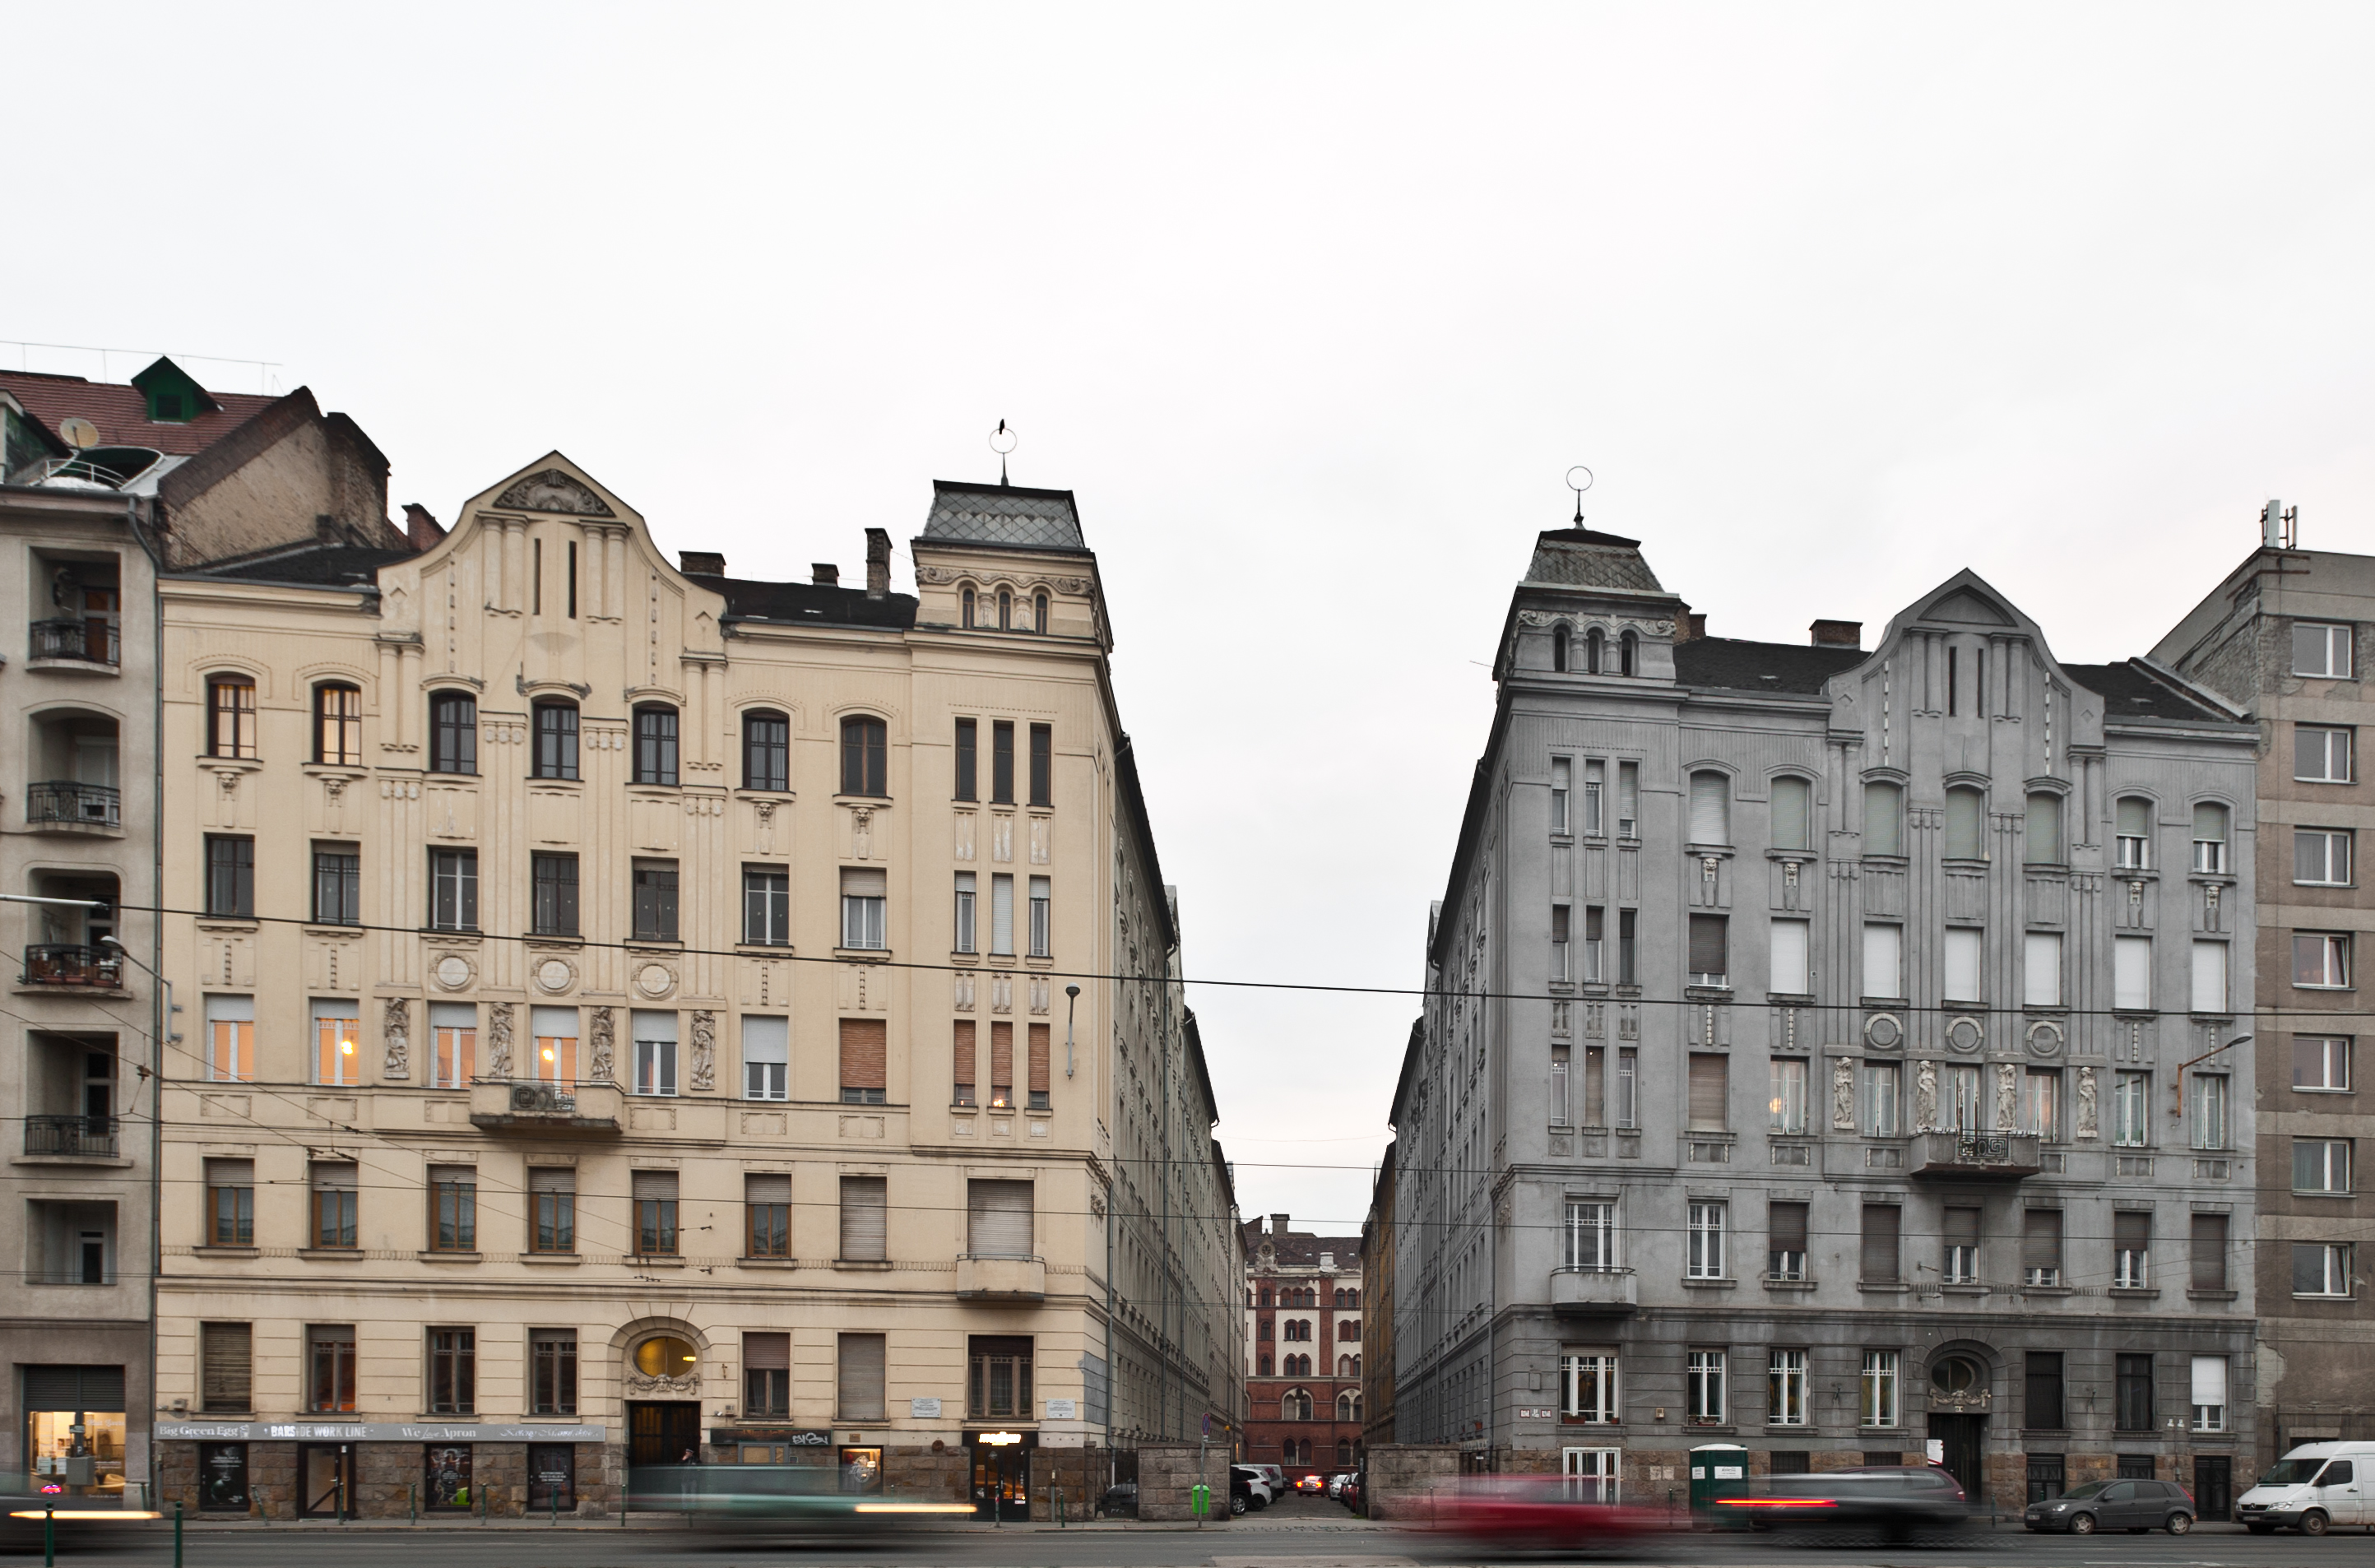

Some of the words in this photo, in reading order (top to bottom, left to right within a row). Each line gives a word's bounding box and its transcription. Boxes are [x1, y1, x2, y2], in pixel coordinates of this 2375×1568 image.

[159, 1426, 178, 1437] Big
[179, 1426, 215, 1437] Green
[216, 1426, 239, 1437] Egg
[313, 1426, 343, 1437] WORK
[346, 1427, 367, 1437] LINE
[402, 1427, 420, 1437] We
[441, 1427, 476, 1440] Apron
